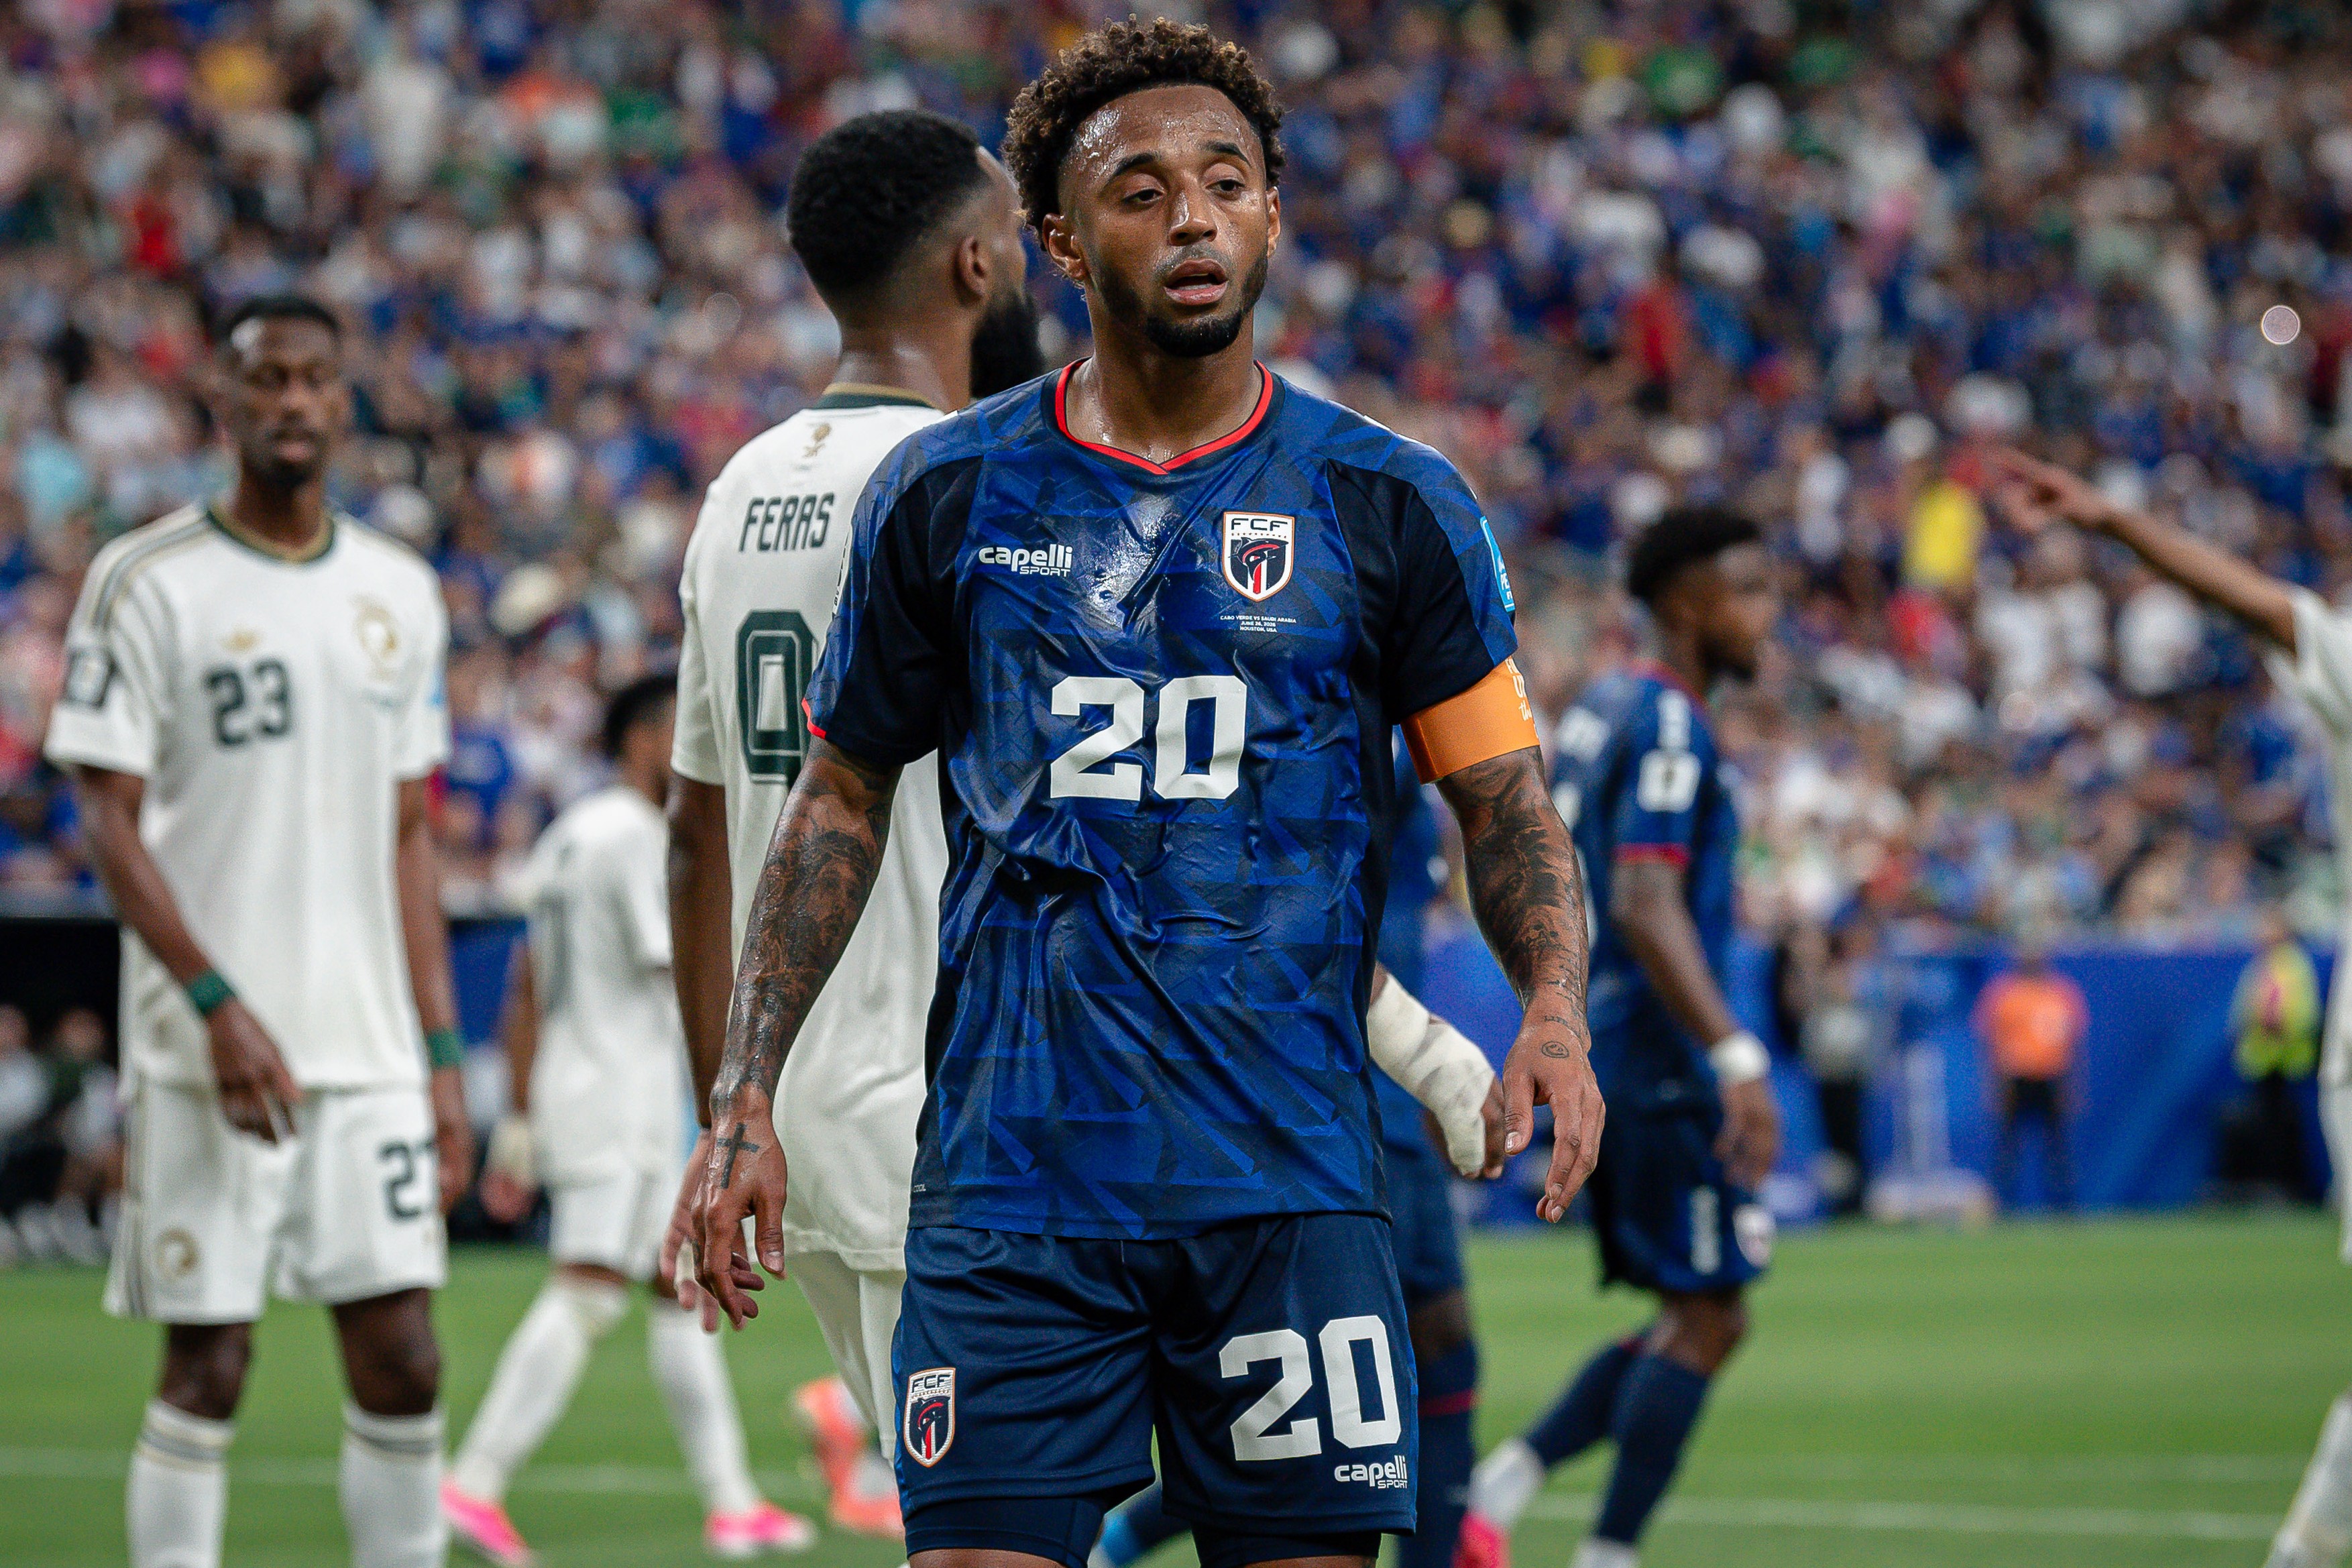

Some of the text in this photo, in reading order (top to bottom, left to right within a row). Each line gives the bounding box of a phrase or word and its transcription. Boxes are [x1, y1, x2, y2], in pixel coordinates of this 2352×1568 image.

[738, 492, 834, 552] FERAS
[1231, 518, 1288, 531] FCF
[978, 544, 1073, 571] capelli
[1019, 566, 1071, 577] SPORT
[205, 658, 290, 747] 23
[1050, 675, 1247, 801] 20
[377, 1140, 436, 1224] 2
[911, 1374, 951, 1394] FCF
[1219, 1315, 1402, 1461] 20
[1334, 1455, 1408, 1487] capelli
[1377, 1479, 1408, 1489] SPORT
